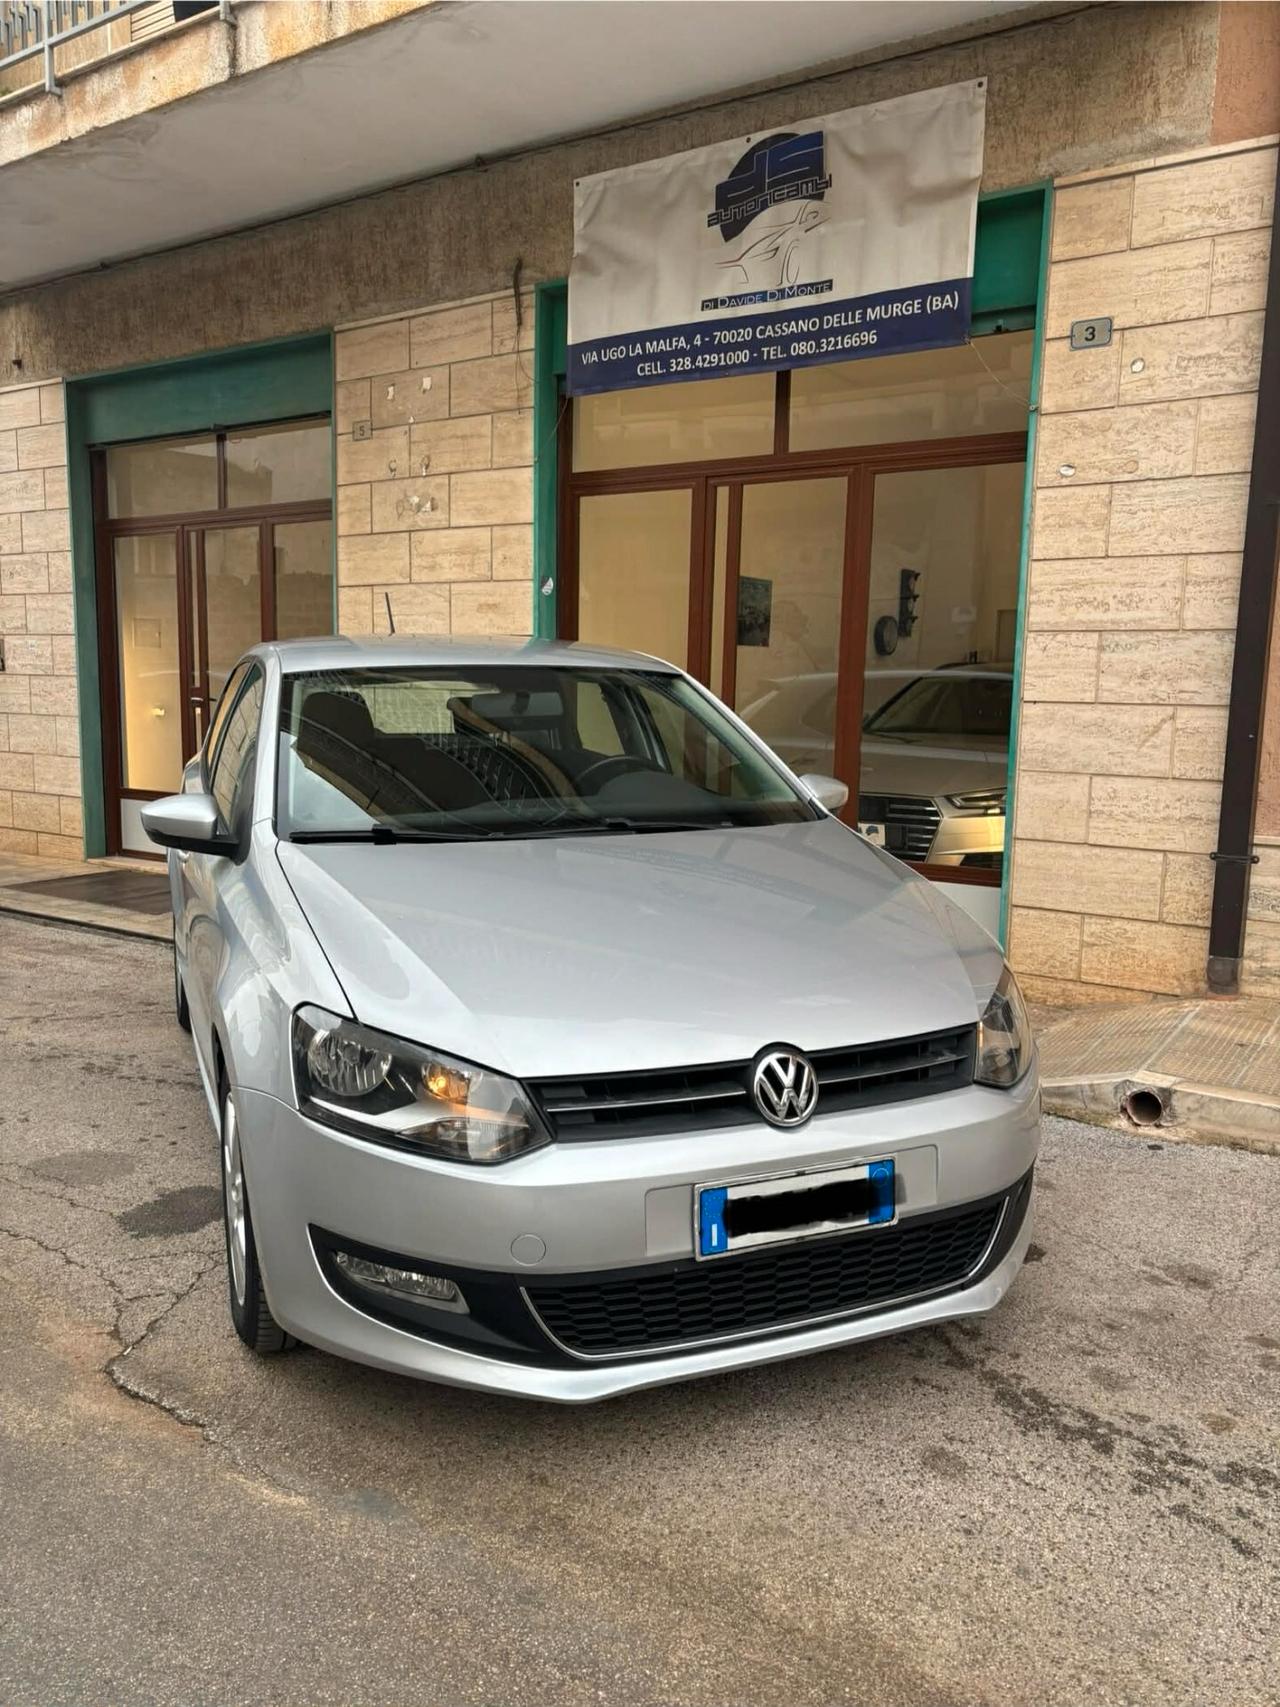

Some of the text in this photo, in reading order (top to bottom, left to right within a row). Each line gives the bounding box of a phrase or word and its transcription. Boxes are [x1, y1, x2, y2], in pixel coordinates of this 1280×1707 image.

[581, 352, 598, 365] VIA
[601, 346, 626, 362] UGO
[629, 344, 643, 357] LA
[645, 336, 691, 354] MALFA,
[693, 334, 701, 347] 4
[713, 327, 752, 345] 70020
[756, 317, 820, 339] CASSANO
[823, 309, 863, 329] DELLE
[866, 299, 922, 321] MURGE
[926, 291, 959, 314] (BA)
[1084, 326, 1096, 341] 3
[636, 361, 667, 376] CELL.
[669, 349, 750, 372] 328.4291000
[760, 346, 787, 361] TEL.
[790, 330, 877, 356] 080.3216696
[359, 425, 365, 437] 5
